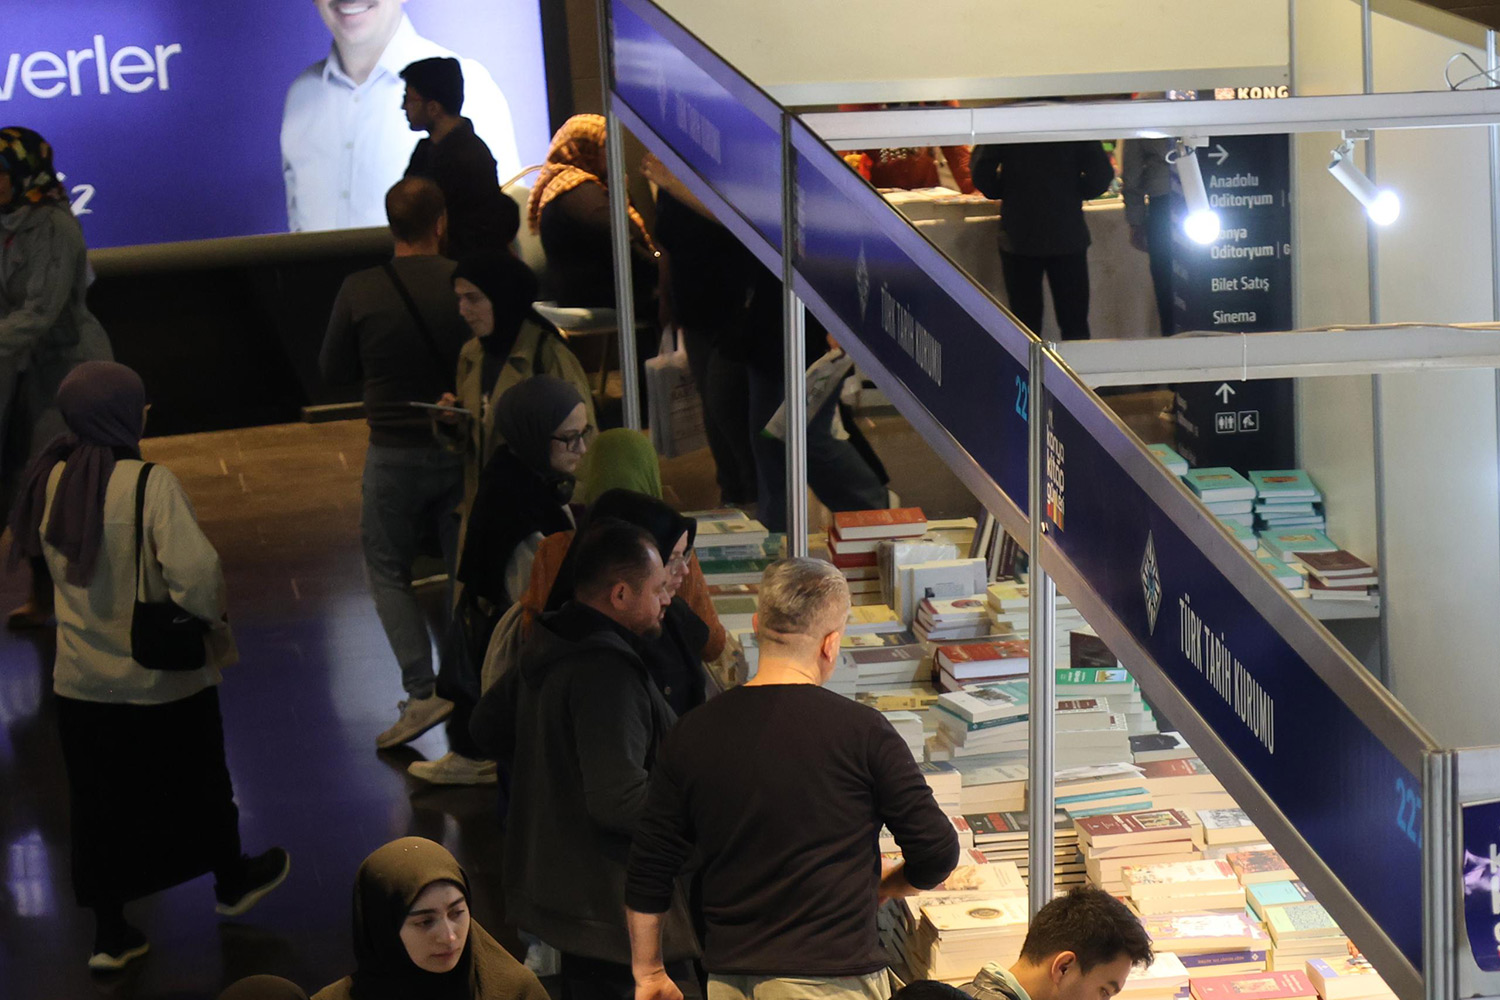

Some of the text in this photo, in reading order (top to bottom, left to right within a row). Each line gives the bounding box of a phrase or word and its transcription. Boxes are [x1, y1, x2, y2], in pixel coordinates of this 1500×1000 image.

[1209, 173, 1260, 189] Anadolu
[1209, 193, 1273, 209] Oditoryum
[1215, 227, 1248, 241] onya
[1210, 244, 1275, 261] Oditoryum
[1211, 276, 1270, 294] Bilet Satış
[1212, 310, 1257, 325] Sinema
[1015, 374, 1030, 423] 22
[1179, 592, 1275, 755] TÜRK TARİH KURUMU
